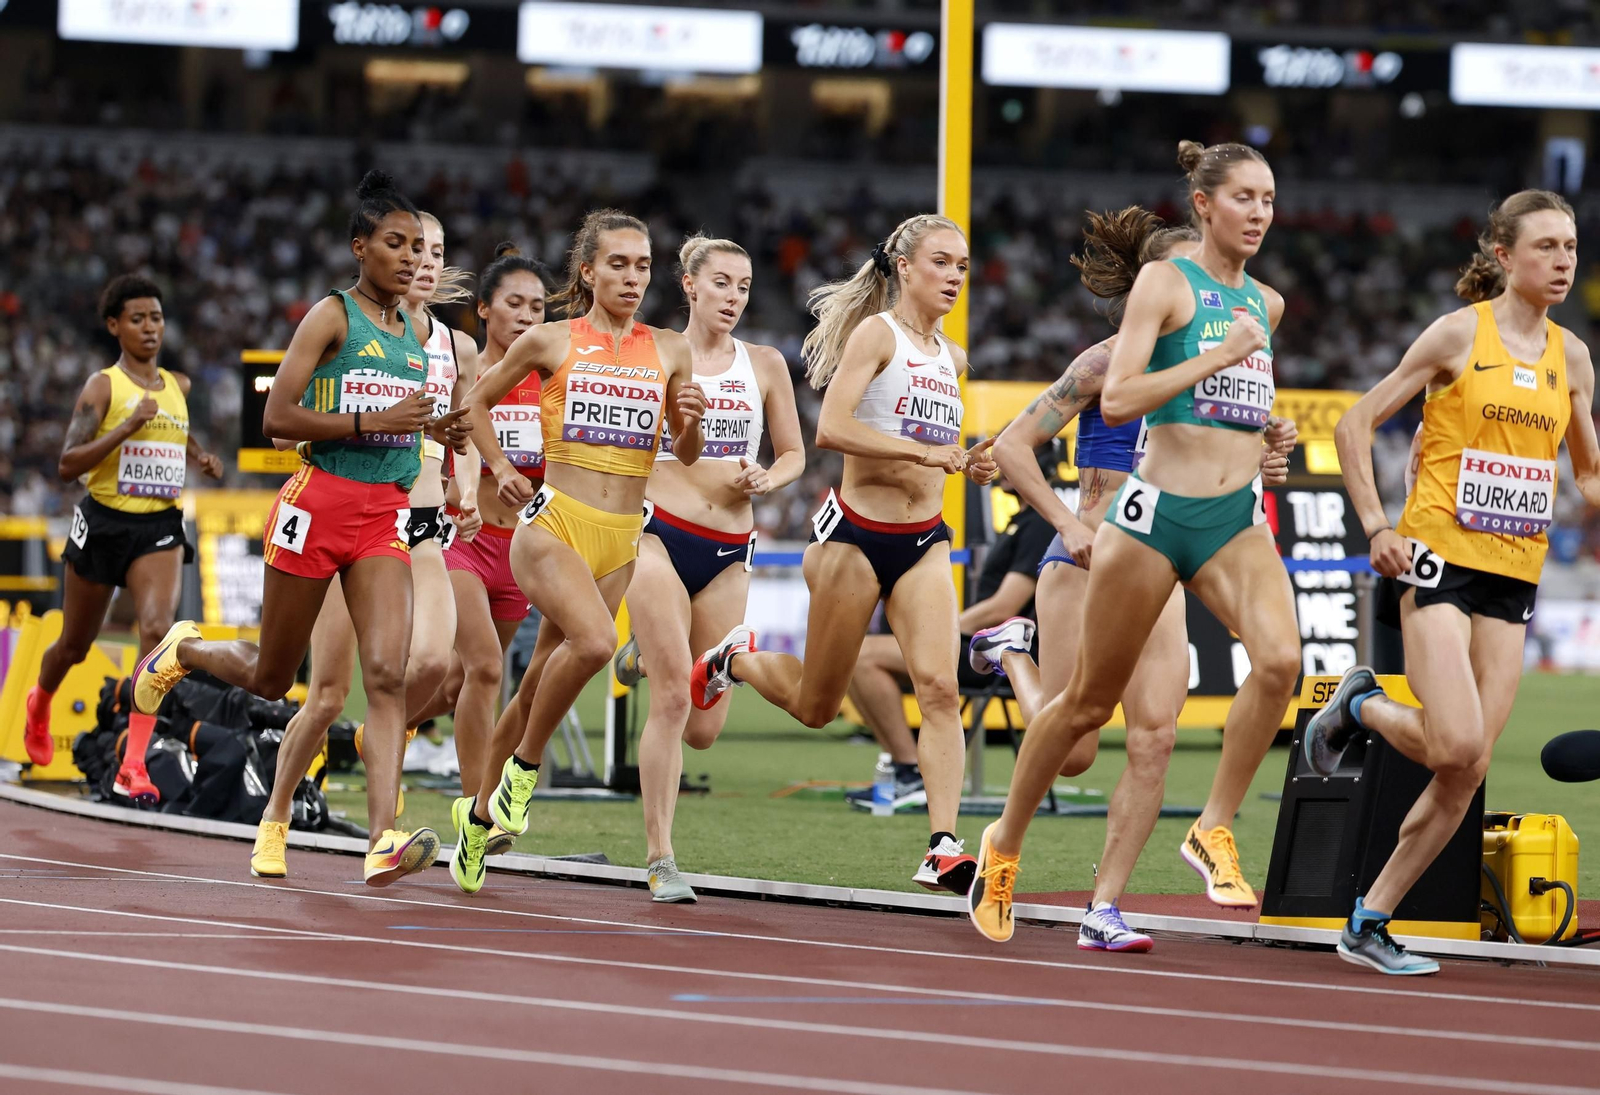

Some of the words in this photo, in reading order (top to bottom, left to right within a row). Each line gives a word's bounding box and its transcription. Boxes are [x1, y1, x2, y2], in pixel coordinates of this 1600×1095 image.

[569, 380, 660, 402] HONDA
[1514, 371, 1535, 384] WGV
[571, 401, 653, 430] PRIETO
[1482, 403, 1558, 433] GERMANY
[123, 445, 184, 460] HONDA
[123, 463, 183, 484] ABAROGE
[1464, 457, 1552, 482] HONDA
[525, 492, 546, 519] 8
[1123, 489, 1143, 522] 6
[1463, 482, 1548, 514] BURKARD
[74, 513, 87, 539] 19
[1287, 491, 1346, 538] TUR
[282, 514, 299, 545] 4
[1187, 829, 1216, 875] NITRO
[1081, 923, 1105, 942] NITRO
